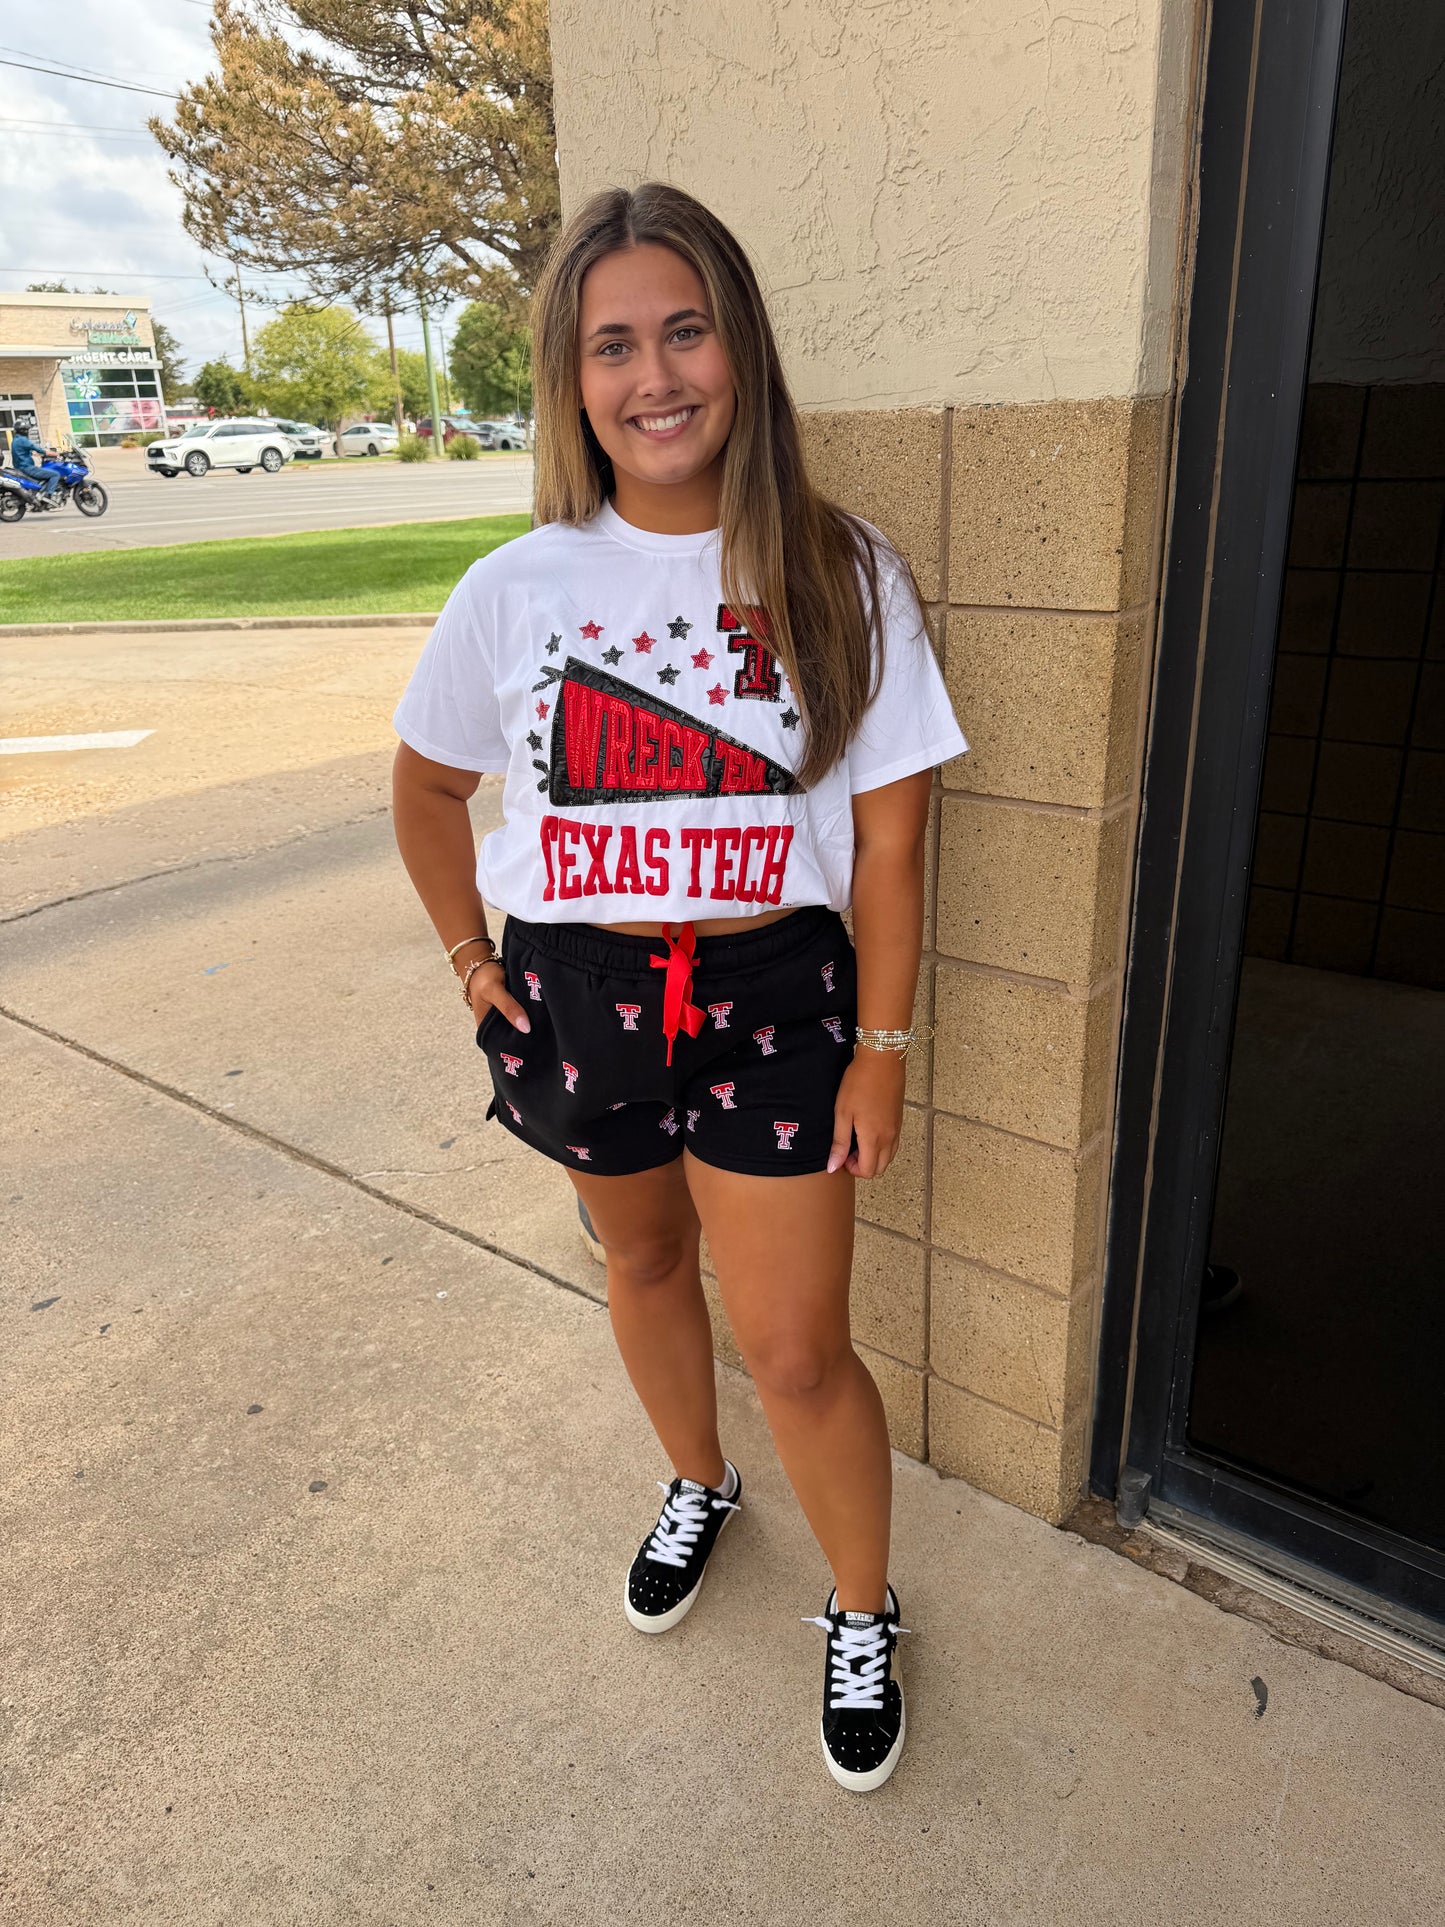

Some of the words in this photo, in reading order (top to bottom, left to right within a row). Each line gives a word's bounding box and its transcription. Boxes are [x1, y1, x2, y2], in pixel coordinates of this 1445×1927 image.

[117, 351, 151, 363] CARE
[563, 679, 710, 791] WRECK
[540, 815, 671, 902] TEXAS
[680, 824, 795, 906] TECH
